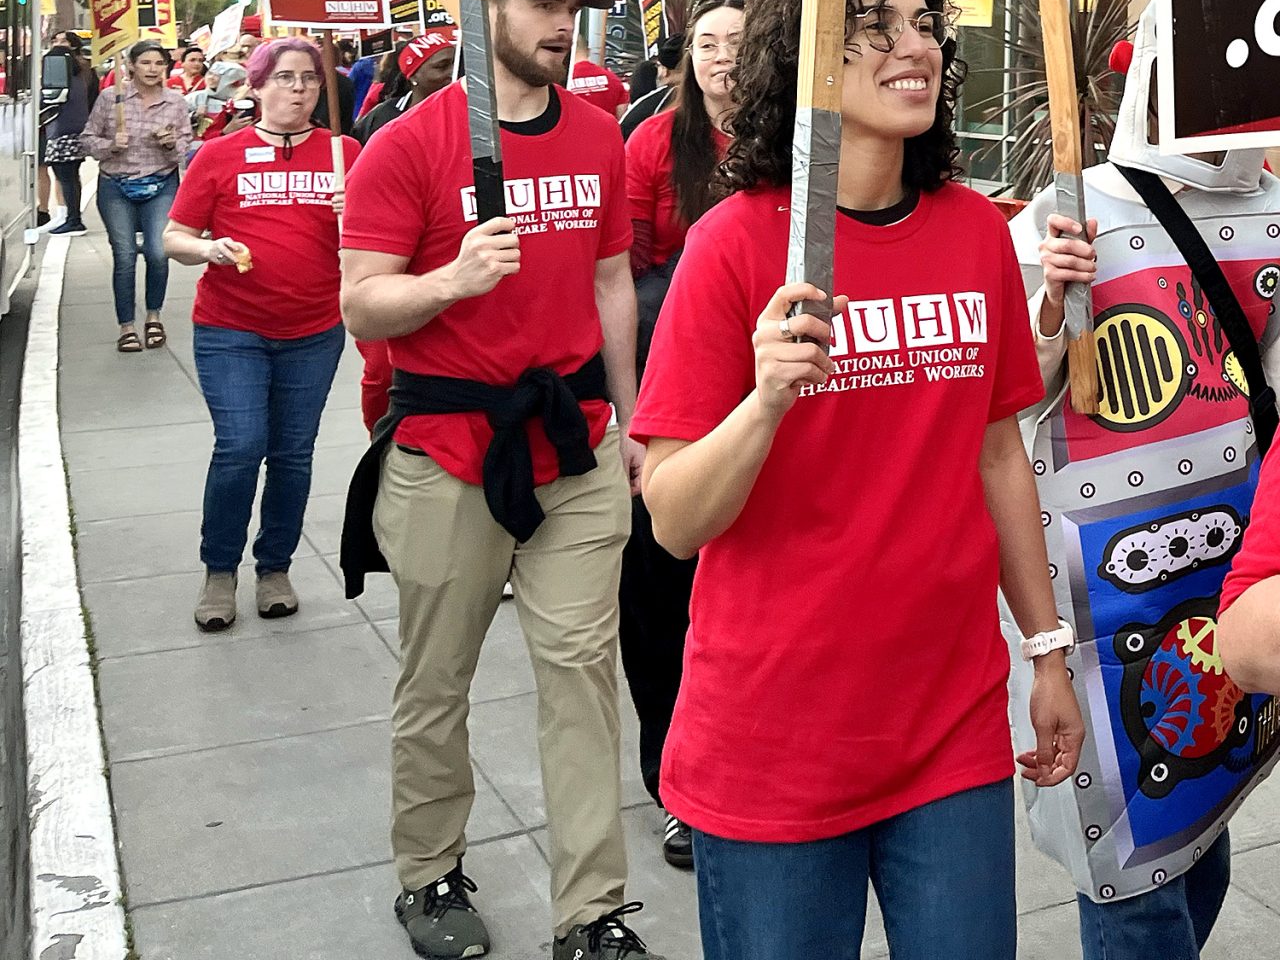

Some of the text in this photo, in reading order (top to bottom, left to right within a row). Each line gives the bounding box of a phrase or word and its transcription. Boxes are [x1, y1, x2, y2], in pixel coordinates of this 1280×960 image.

[327, 1, 377, 12] NUHW
[240, 173, 335, 192] NUHW
[509, 208, 594, 225] ONAL UNION OF
[554, 220, 597, 232] WORKERS
[831, 347, 979, 375] ATIONAL UNION OF
[924, 364, 985, 383] WORKERS
